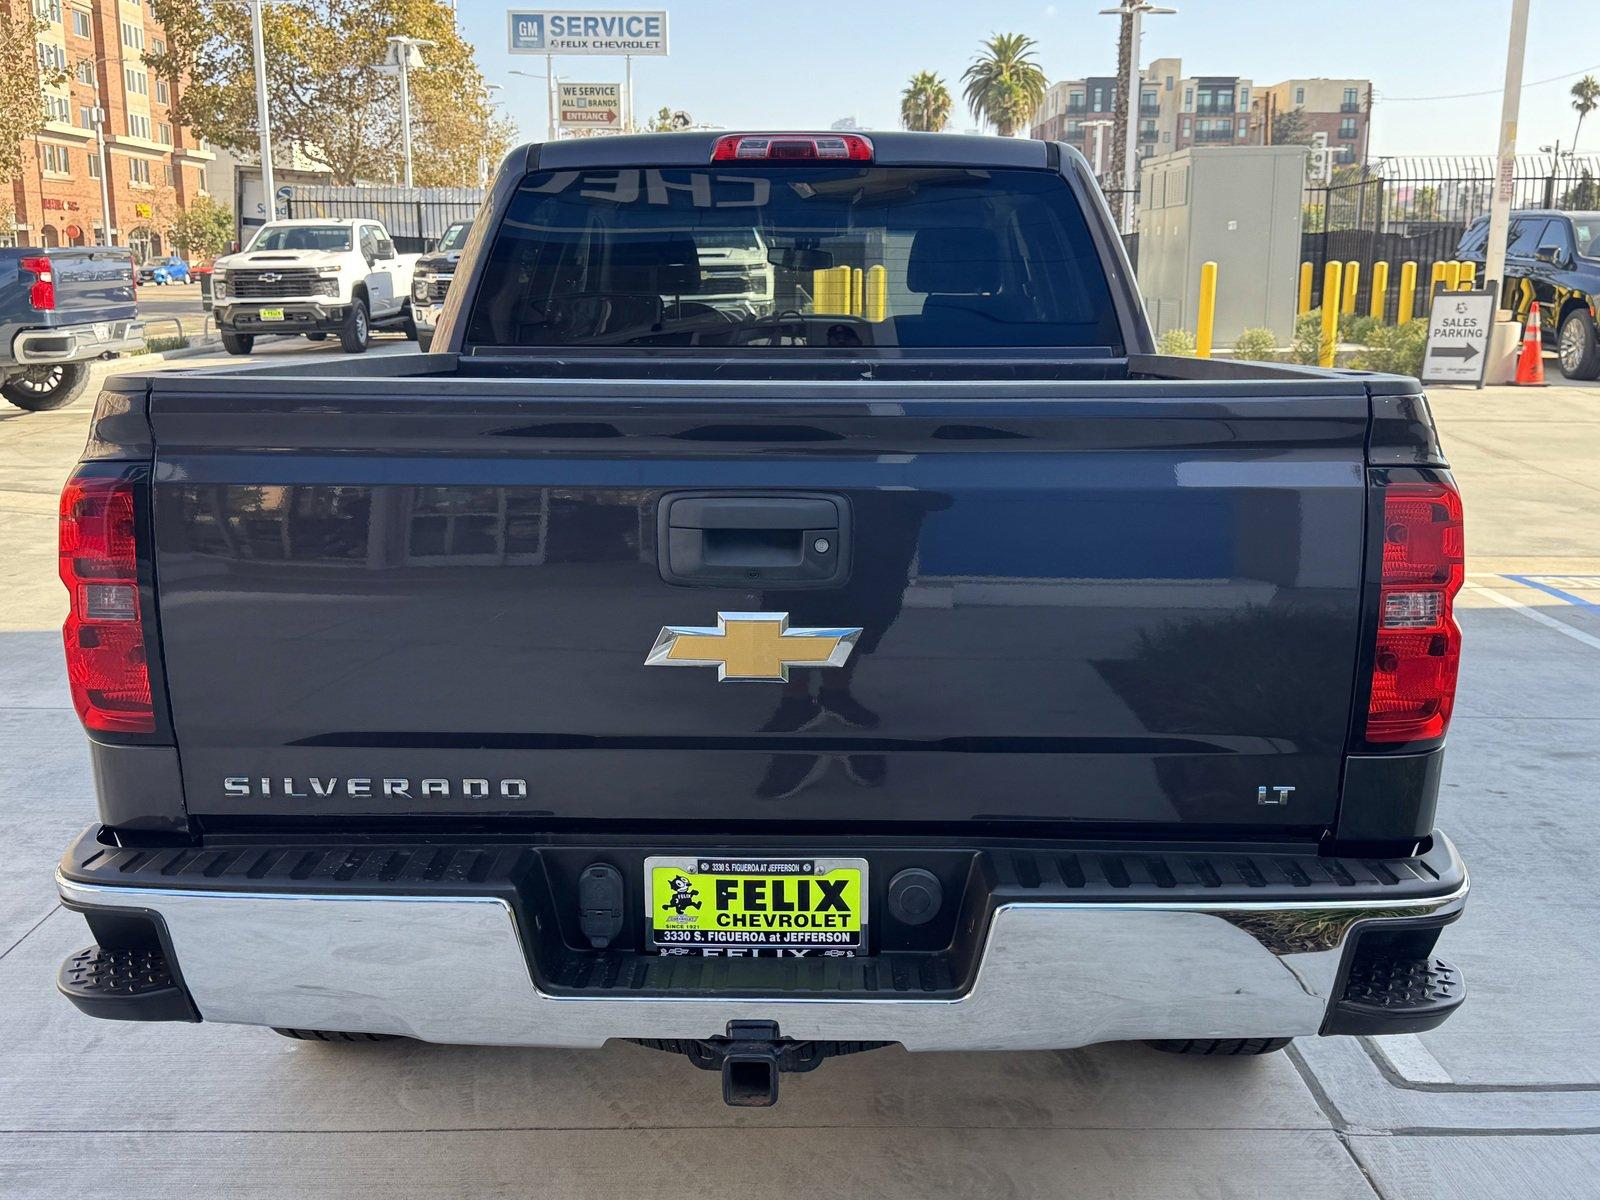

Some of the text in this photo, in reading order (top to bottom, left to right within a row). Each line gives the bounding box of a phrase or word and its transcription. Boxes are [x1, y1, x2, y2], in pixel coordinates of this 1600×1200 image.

[519, 21, 538, 37] GM
[550, 16, 661, 37] SERVICE
[560, 40, 661, 49] FELIX CHEVROLET
[562, 86, 615, 96] WE SERVICE
[562, 99, 575, 107] ALL
[588, 99, 618, 107] BRANDS
[566, 112, 608, 121] ENTRANCE
[1442, 317, 1478, 328] SALES
[1433, 328, 1483, 339] PARKING
[224, 777, 529, 799] SILVERADO
[1258, 786, 1296, 806] LT
[712, 863, 800, 873] 3330 S. FIGUEROA AT JEFFERSON
[715, 879, 852, 912] FELIX
[716, 912, 852, 928] CHEVROLET
[664, 931, 850, 943] 3330 S. FIGUEROA at JEFFERSON
